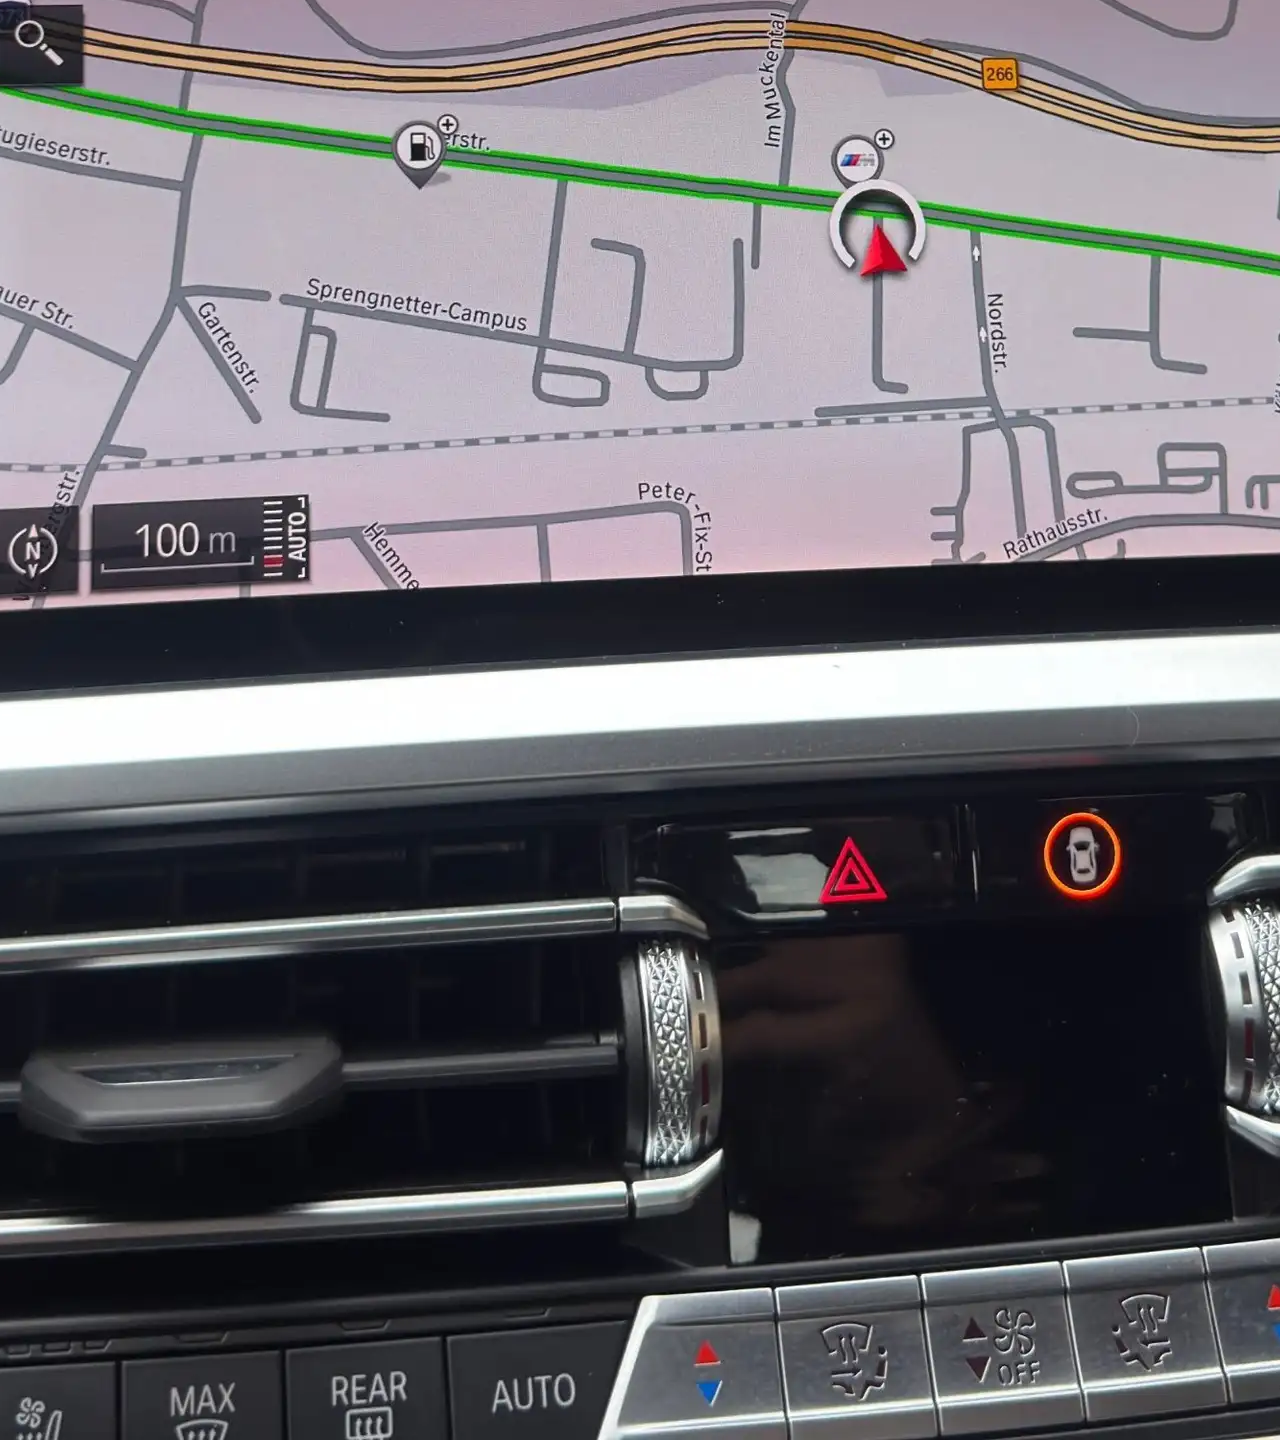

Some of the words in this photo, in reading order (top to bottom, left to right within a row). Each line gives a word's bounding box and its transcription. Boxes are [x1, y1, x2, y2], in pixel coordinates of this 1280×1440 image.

[758, 12, 786, 122] Muckental
[985, 64, 1015, 84] 266
[764, 127, 781, 149] Im
[41, 300, 74, 329] Str.
[306, 277, 528, 331] Sprengnetter-Campus
[197, 300, 261, 393] Gartenstr.
[987, 292, 1007, 374] Nordstr.
[134, 522, 200, 557] 100
[208, 527, 237, 554] m
[287, 510, 308, 562] AUTO
[1002, 505, 1109, 559] Rathausstr.
[25, 541, 41, 561] N
[331, 1370, 408, 1406] REAR
[996, 1359, 1041, 1387] OFF
[169, 1382, 236, 1418] MAX
[491, 1371, 577, 1414] AUTO
